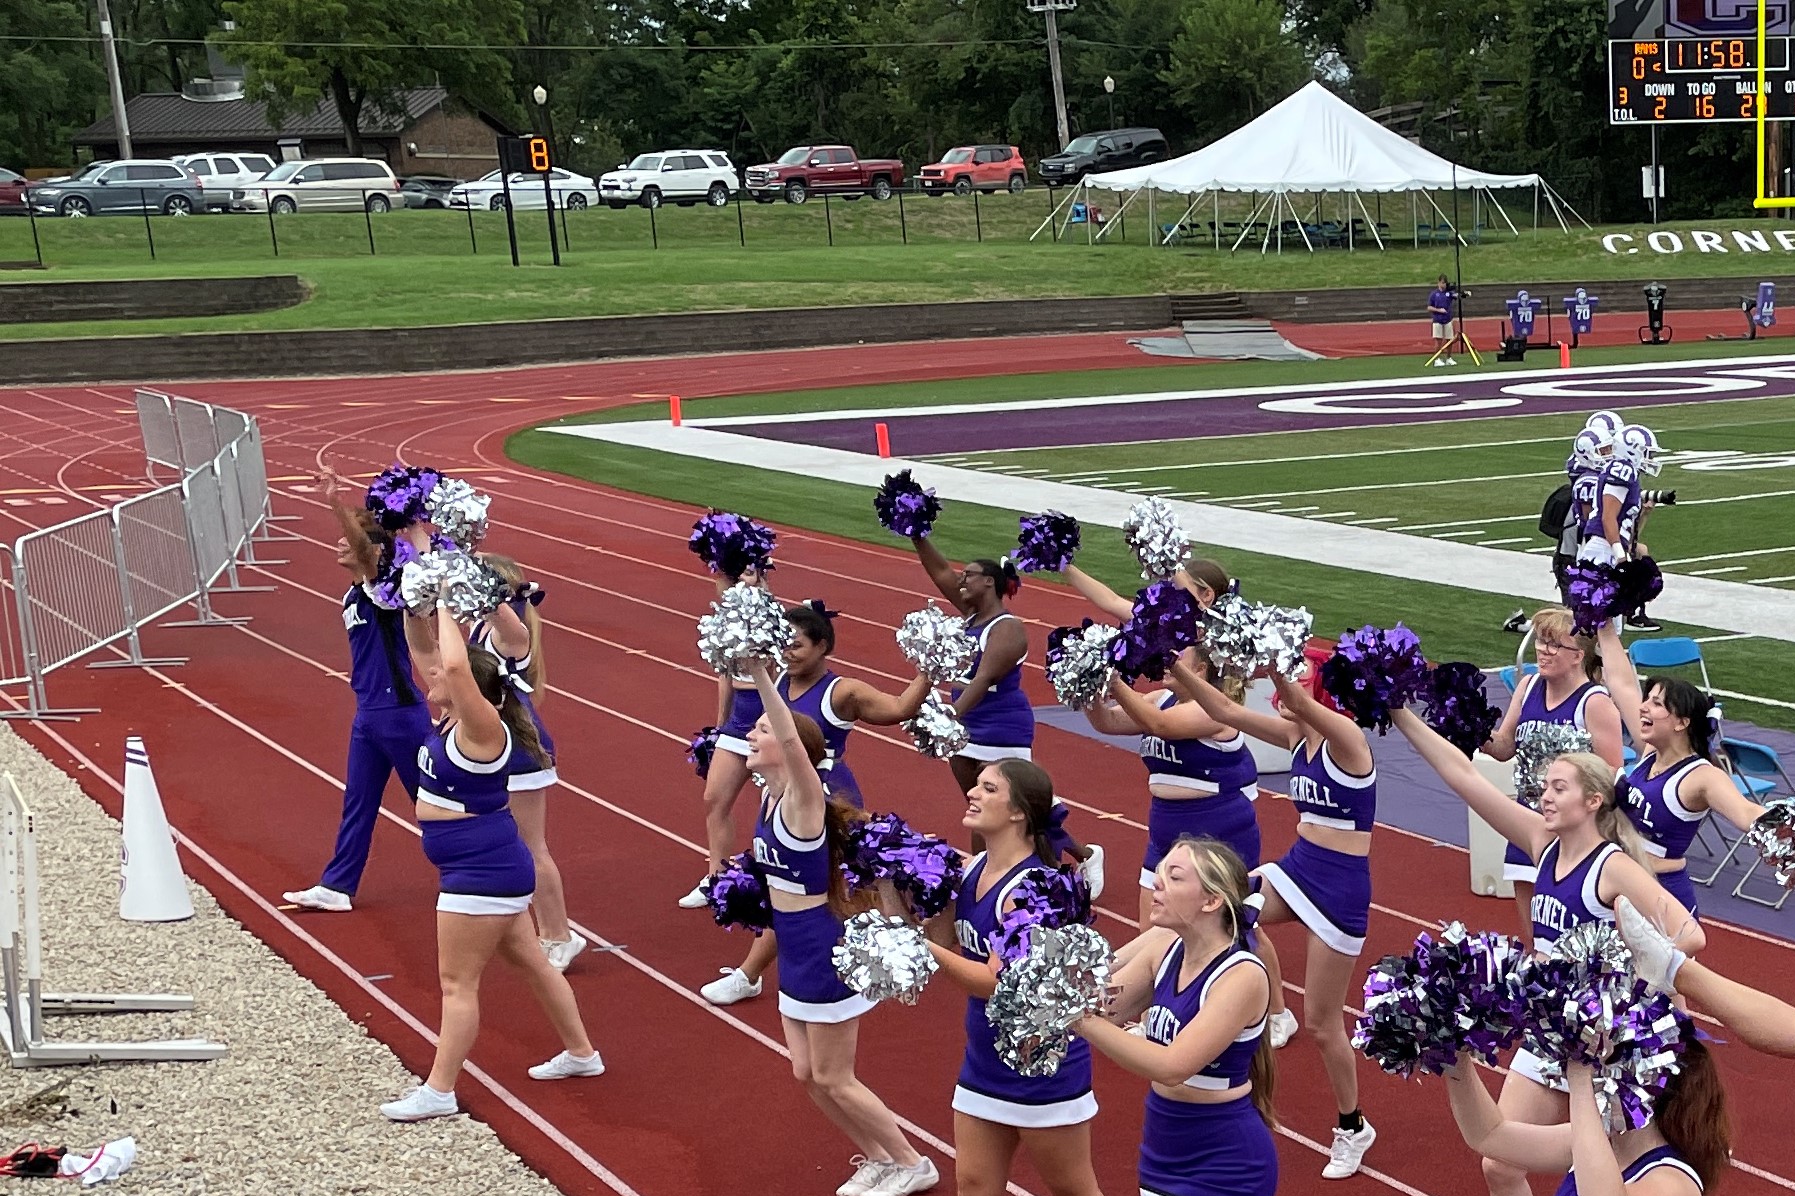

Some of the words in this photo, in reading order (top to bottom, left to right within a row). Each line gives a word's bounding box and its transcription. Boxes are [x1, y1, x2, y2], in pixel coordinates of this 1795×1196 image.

[1635, 43, 1658, 54] RAMS
[1633, 57, 1645, 79] 0
[1645, 83, 1675, 96] DOWN
[1687, 83, 1700, 95] TO
[1702, 83, 1716, 95] GO
[1736, 81, 1757, 94] BALL
[1619, 87, 1628, 105] 3
[1655, 97, 1666, 118] 2
[1696, 95, 1715, 118] 16
[1614, 109, 1637, 121] T.O.L.
[530, 138, 549, 171] 8
[1518, 310, 1532, 322] 70
[1576, 308, 1590, 320] 70
[1610, 462, 1632, 481] 20
